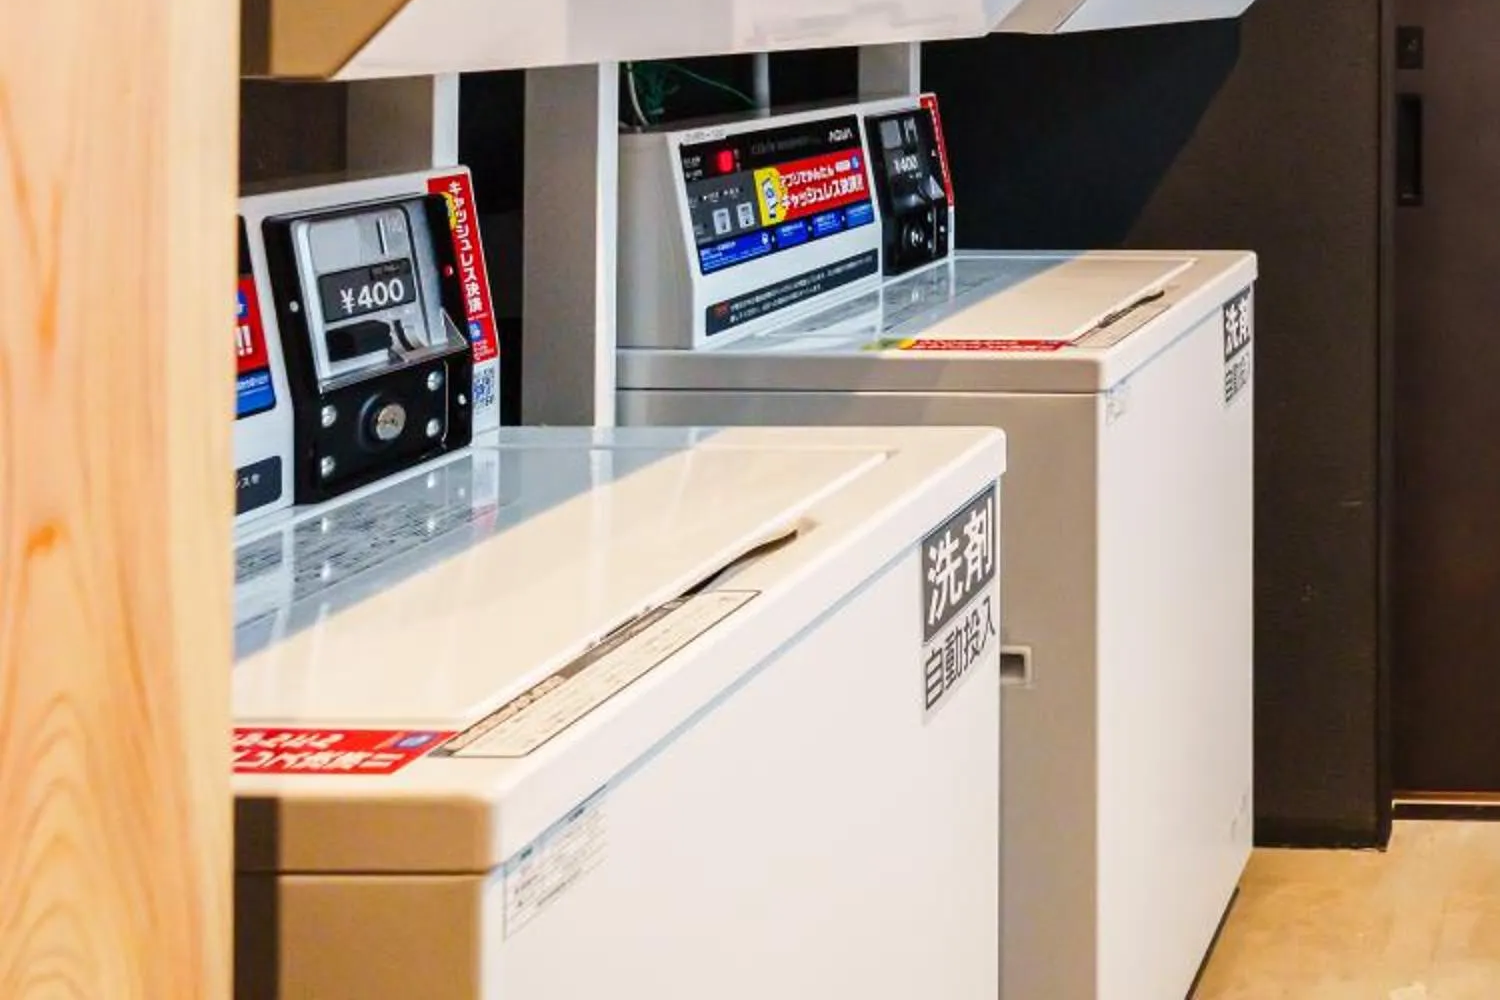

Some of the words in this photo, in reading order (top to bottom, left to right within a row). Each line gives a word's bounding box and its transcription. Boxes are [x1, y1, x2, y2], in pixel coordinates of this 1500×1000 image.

[340, 277, 405, 314] ¥400
[927, 496, 993, 626] 洗剤
[925, 594, 996, 711] 自動投入
